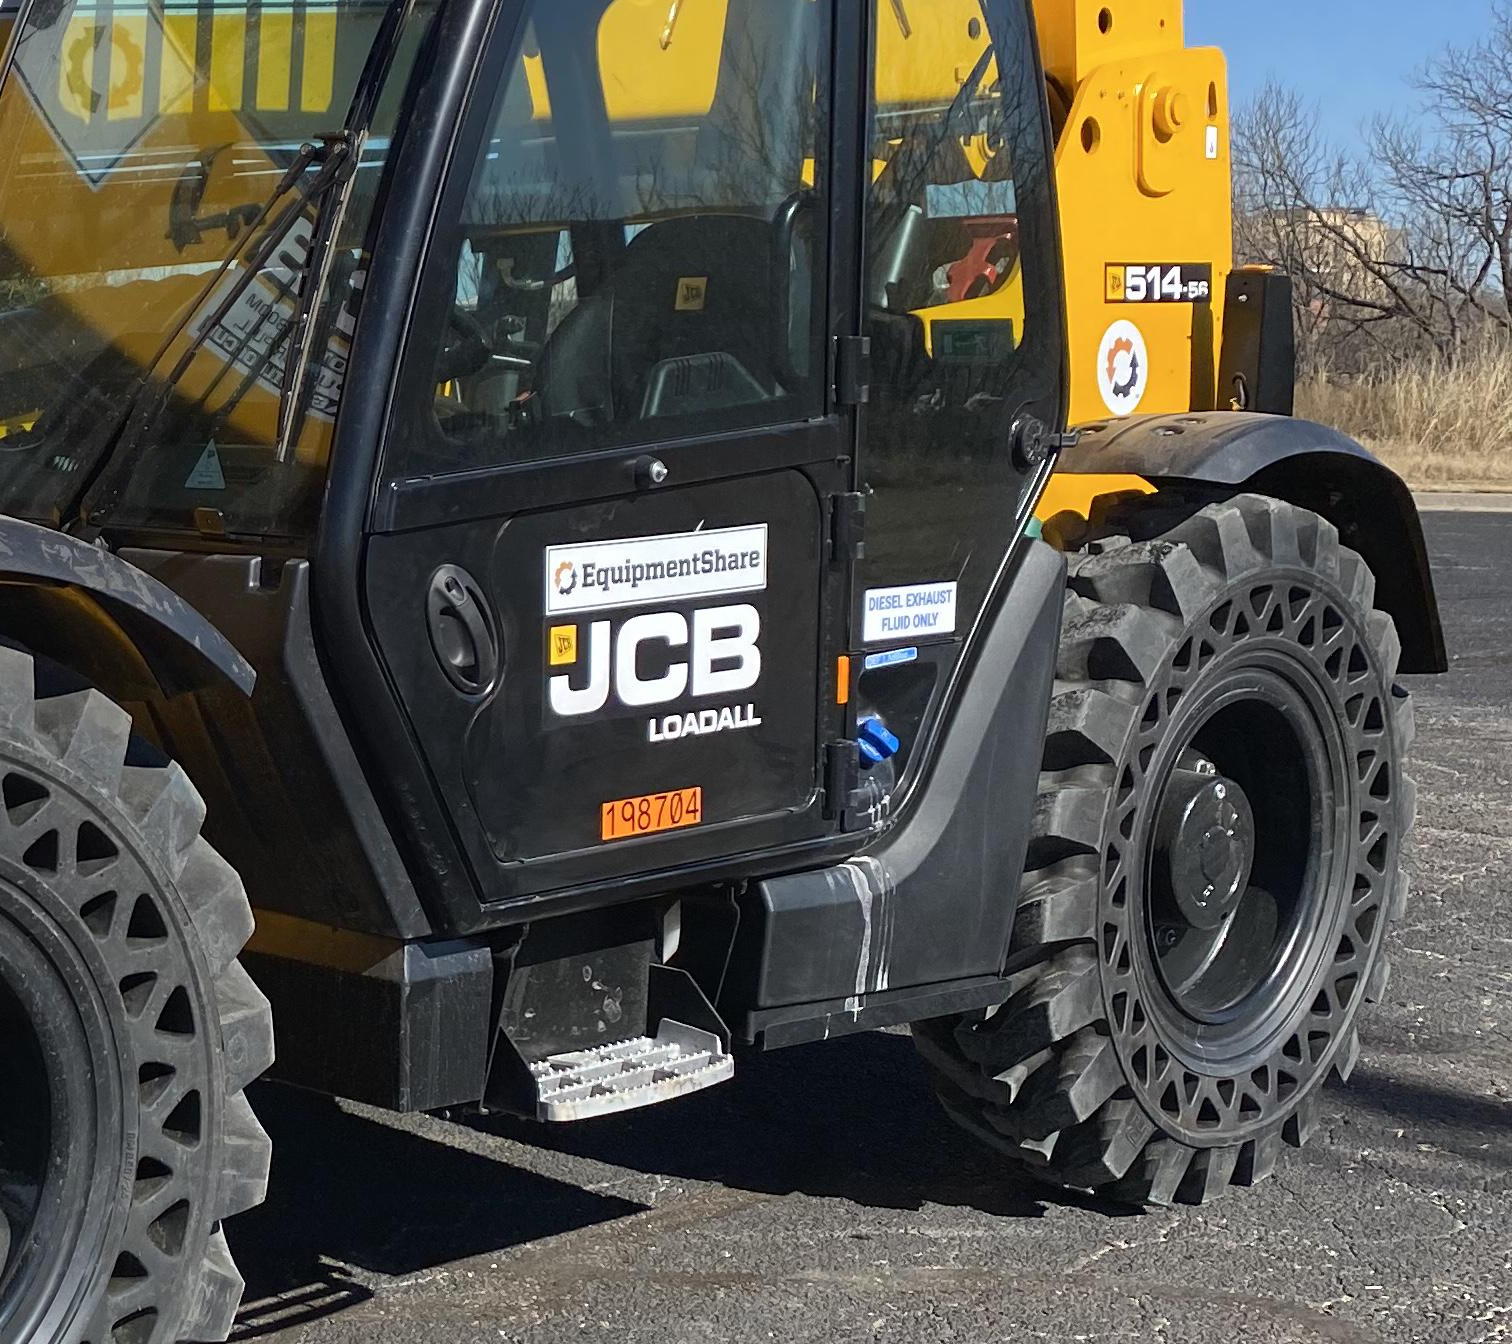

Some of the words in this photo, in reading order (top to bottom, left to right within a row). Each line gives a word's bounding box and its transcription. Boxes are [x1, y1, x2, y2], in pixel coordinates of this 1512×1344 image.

[582, 548, 761, 591] EquipmentShare
[868, 594, 904, 612] DIESEL
[906, 589, 953, 608] EXHAUST
[881, 615, 911, 632] FLUID
[913, 612, 939, 629] ONLY
[549, 603, 762, 716] JCB
[649, 703, 762, 743] LOADALL
[606, 789, 699, 836] 198704
